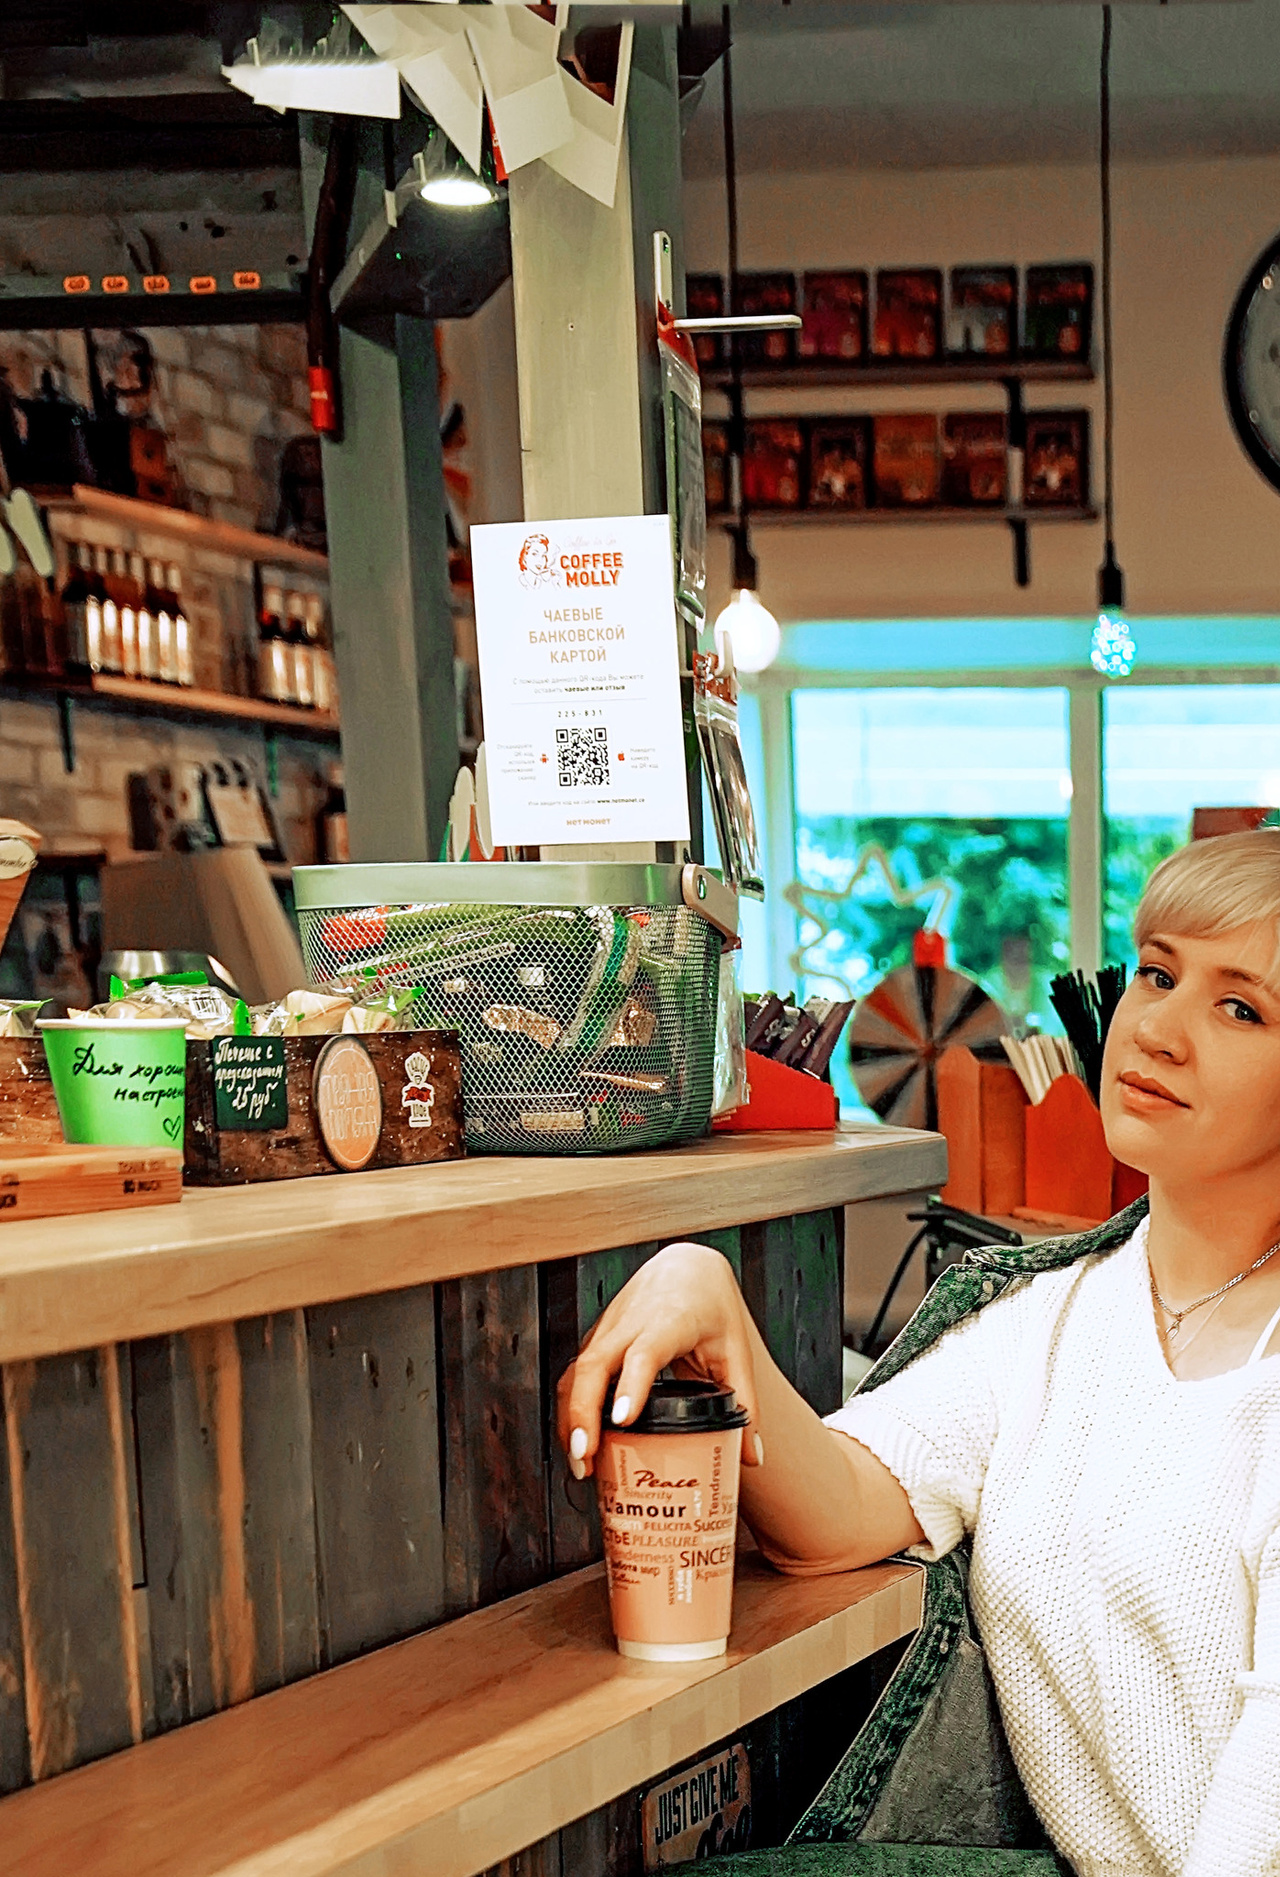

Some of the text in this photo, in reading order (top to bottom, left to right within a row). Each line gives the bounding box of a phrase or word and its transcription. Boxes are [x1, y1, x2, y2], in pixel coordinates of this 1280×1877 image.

[560, 552, 624, 571] COFFEE
[566, 569, 620, 589] MOLLY
[543, 607, 604, 622] ЧАЕВЫЕ
[529, 624, 625, 644] БАНКОВСКОЙ
[550, 646, 607, 663] КАРТОЙ
[73, 1043, 124, 1076] Для
[633, 1470, 700, 1488] Peace
[709, 1446, 722, 1517] Tendresse
[603, 1496, 686, 1518] L'amour
[632, 1535, 699, 1548] PLEASURE
[655, 1781, 688, 1846] JUST
[690, 1765, 718, 1826] GIVE
[719, 1754, 740, 1809] ME
